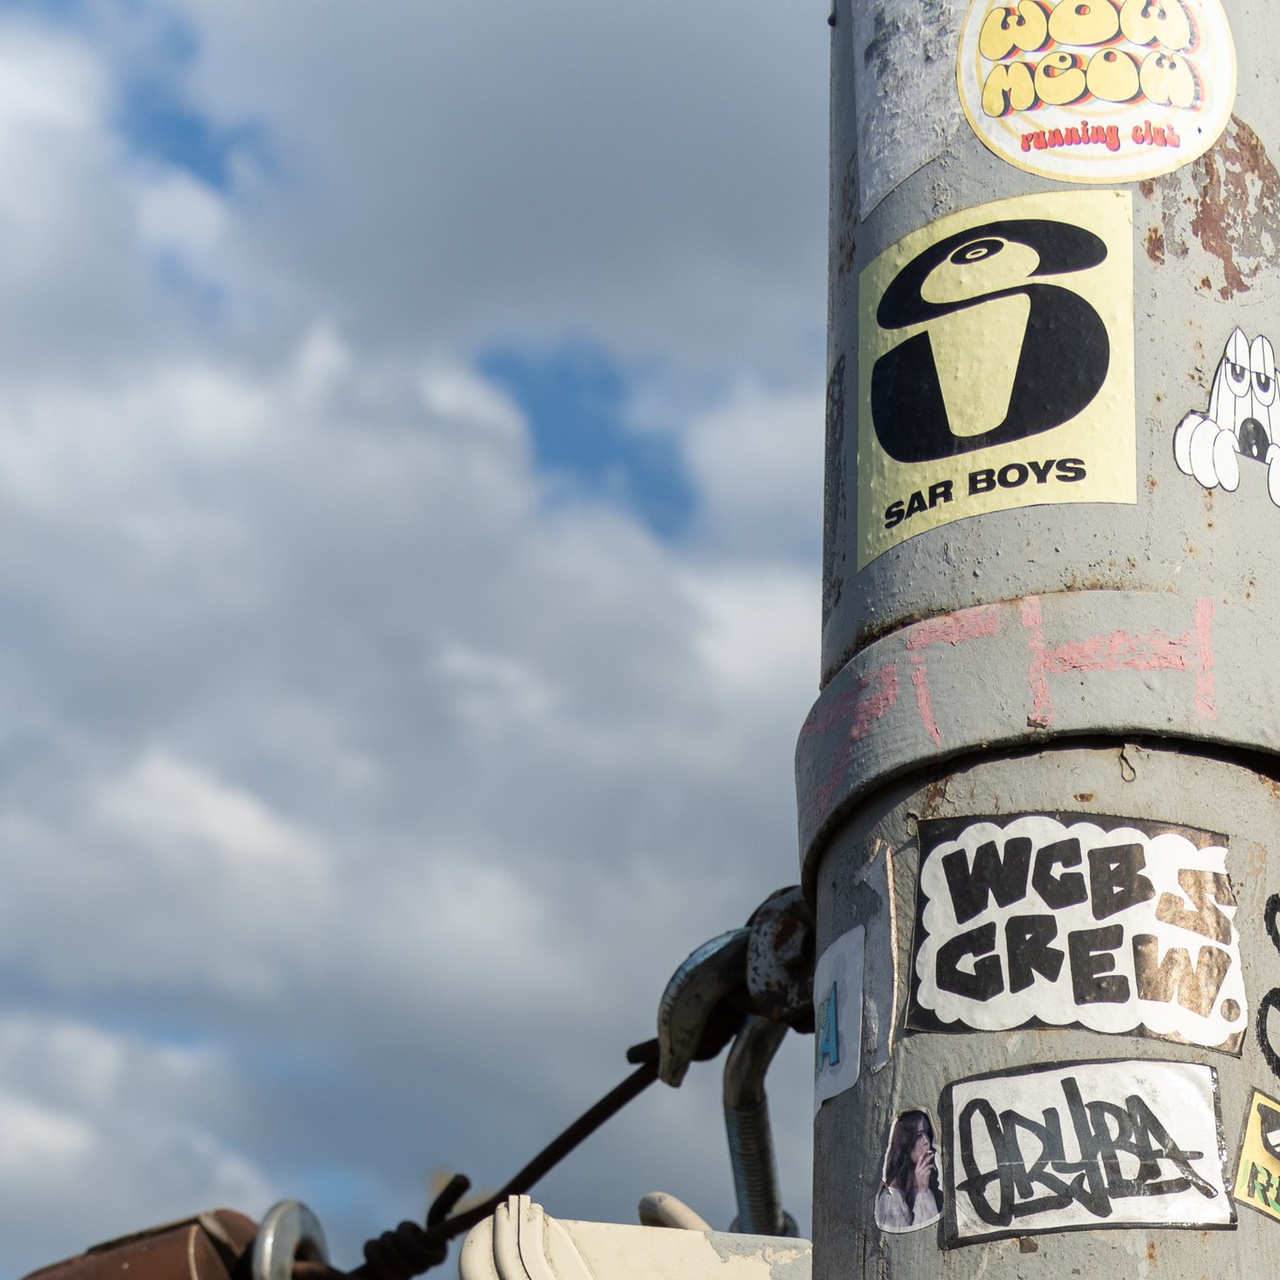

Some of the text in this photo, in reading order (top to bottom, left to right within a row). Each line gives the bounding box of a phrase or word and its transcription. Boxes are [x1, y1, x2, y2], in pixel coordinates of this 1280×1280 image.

[979, 0, 1200, 60] WOW
[981, 48, 1205, 118] MEOW
[1020, 120, 1121, 152] running
[884, 458, 1087, 530] SAR BOYS
